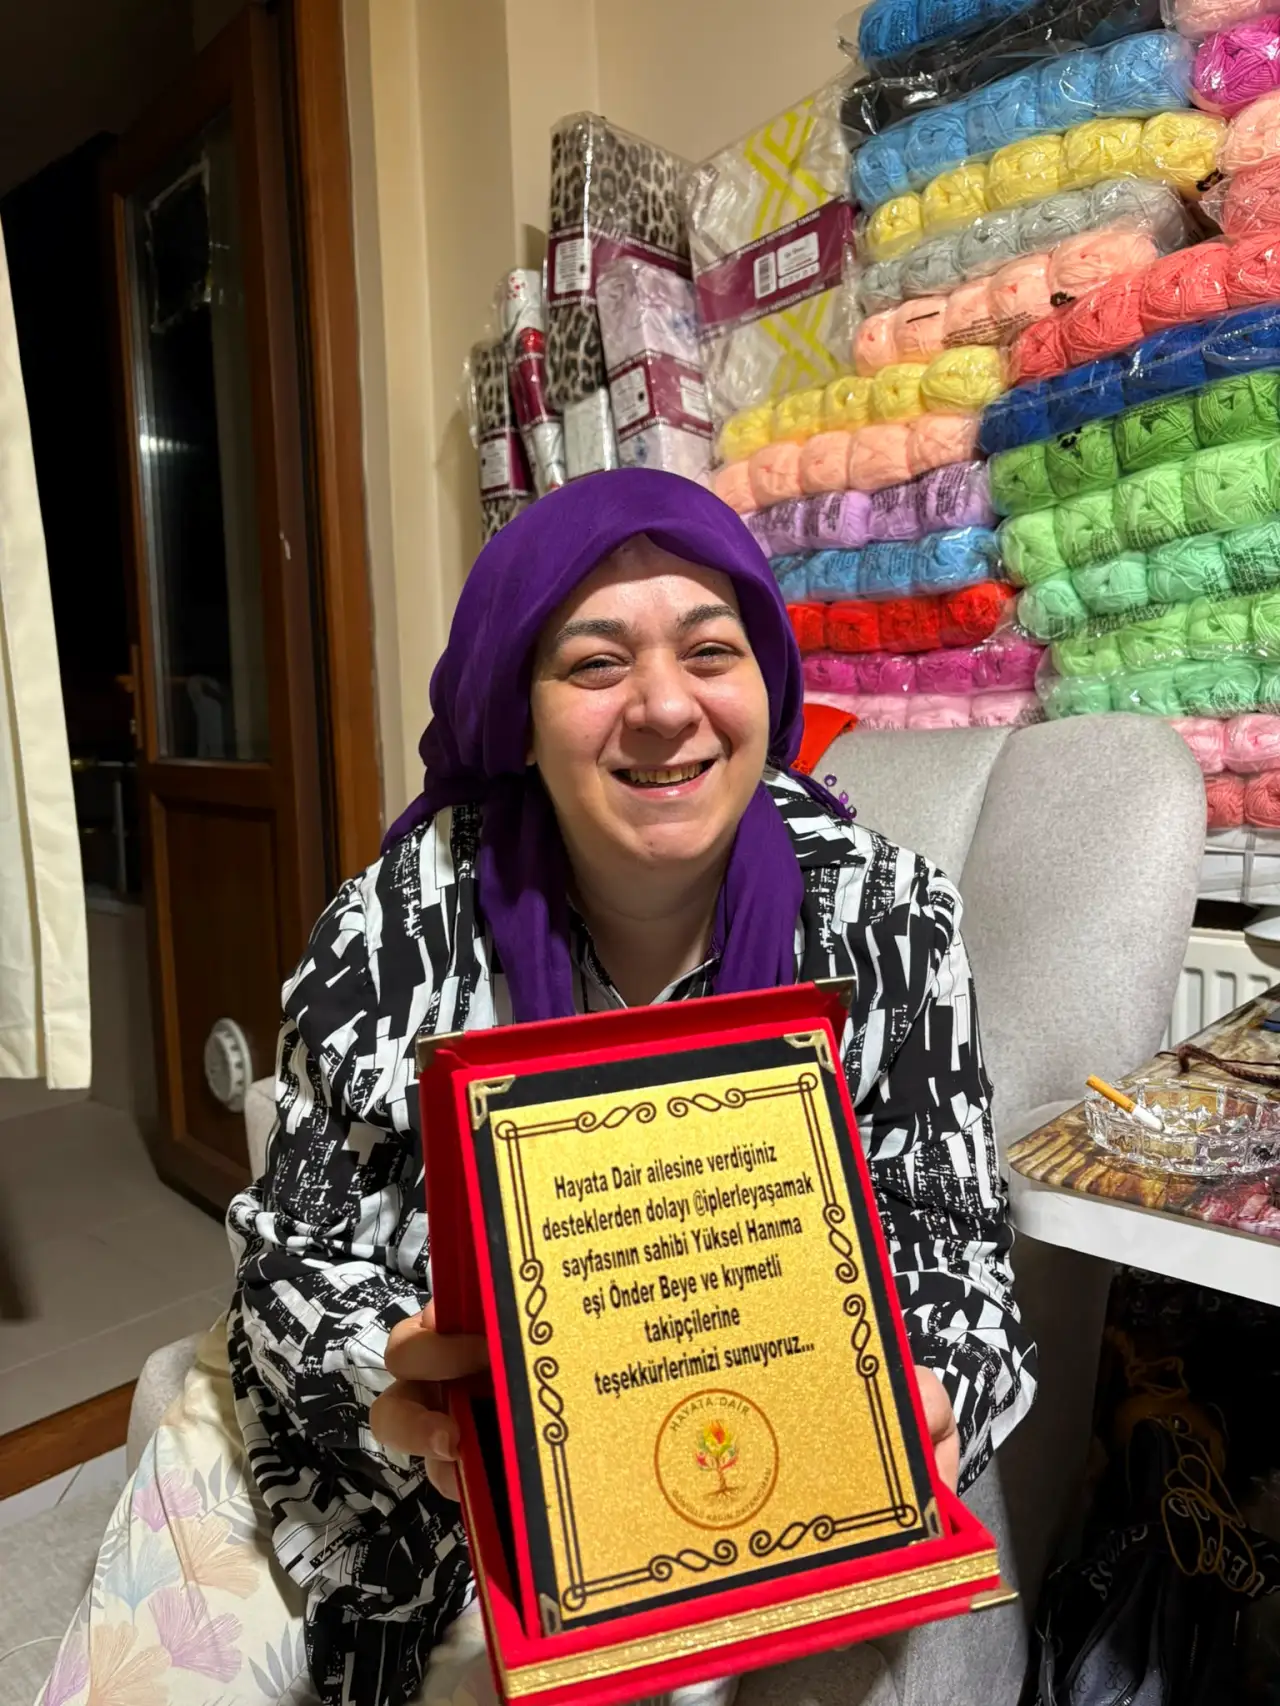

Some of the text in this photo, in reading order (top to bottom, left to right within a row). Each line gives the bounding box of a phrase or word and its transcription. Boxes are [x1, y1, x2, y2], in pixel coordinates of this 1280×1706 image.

[554, 1140, 777, 1202] Hayata Dair ailesine verdiğiniz
[542, 1171, 814, 1242] desteklerden dolayı @iplerleyaşamak
[562, 1216, 803, 1282] sayfasının sahibi Yüksel Hanıma
[582, 1253, 783, 1319] eşi Önder Beye ve kıymetli
[644, 1305, 741, 1344] takipçilerine
[594, 1335, 815, 1398] teşekkürlerimizi sunuyoruz...
[669, 1397, 714, 1432] HAYATA
